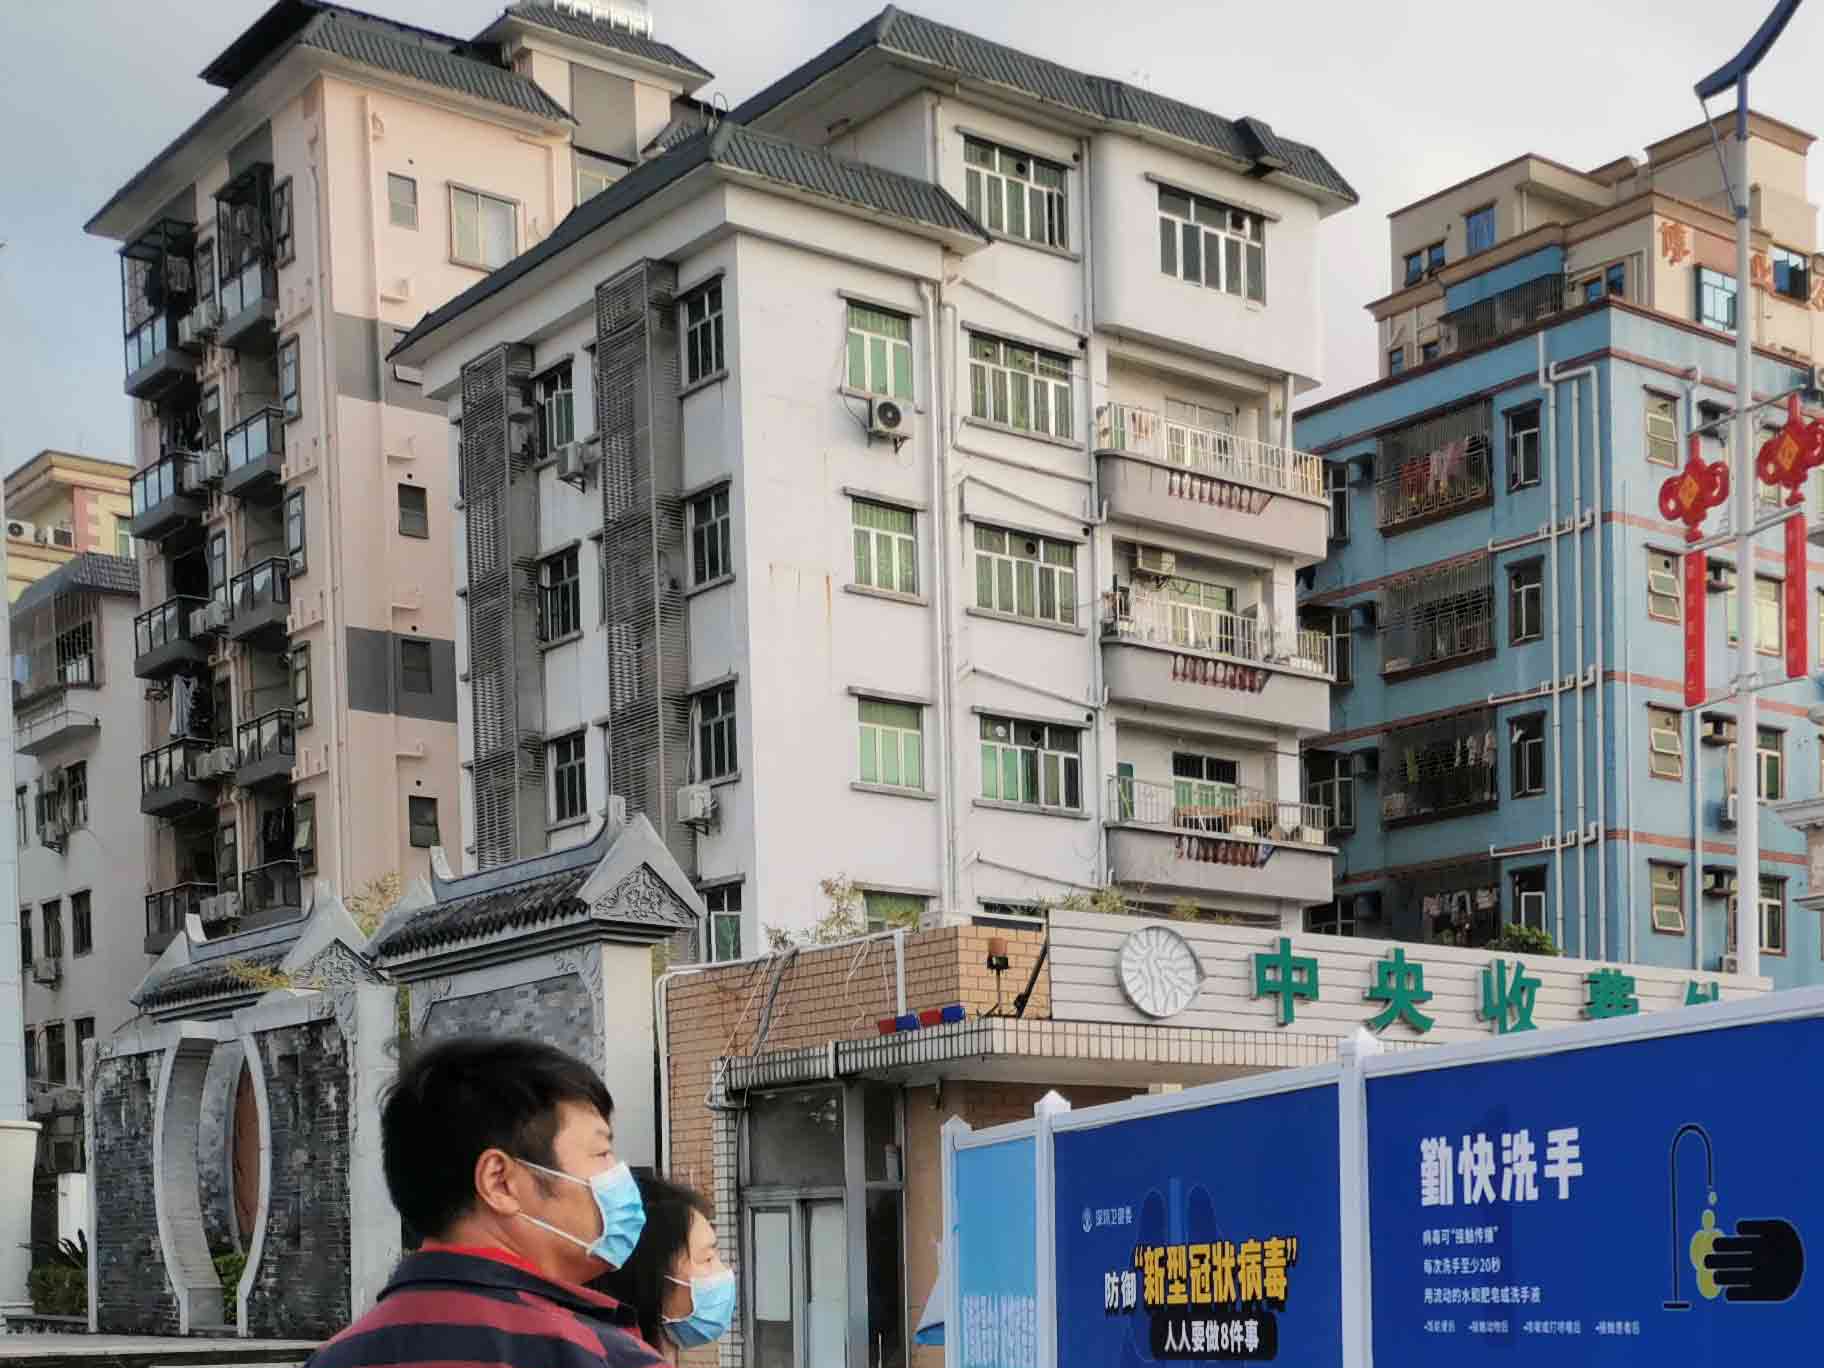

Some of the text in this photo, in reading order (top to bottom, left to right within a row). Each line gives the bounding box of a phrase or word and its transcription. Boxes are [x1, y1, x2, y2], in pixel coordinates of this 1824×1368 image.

[1420, 1127, 1583, 1208] 勤快洗手
[1163, 1318, 1261, 1353] 人人要做8件事
